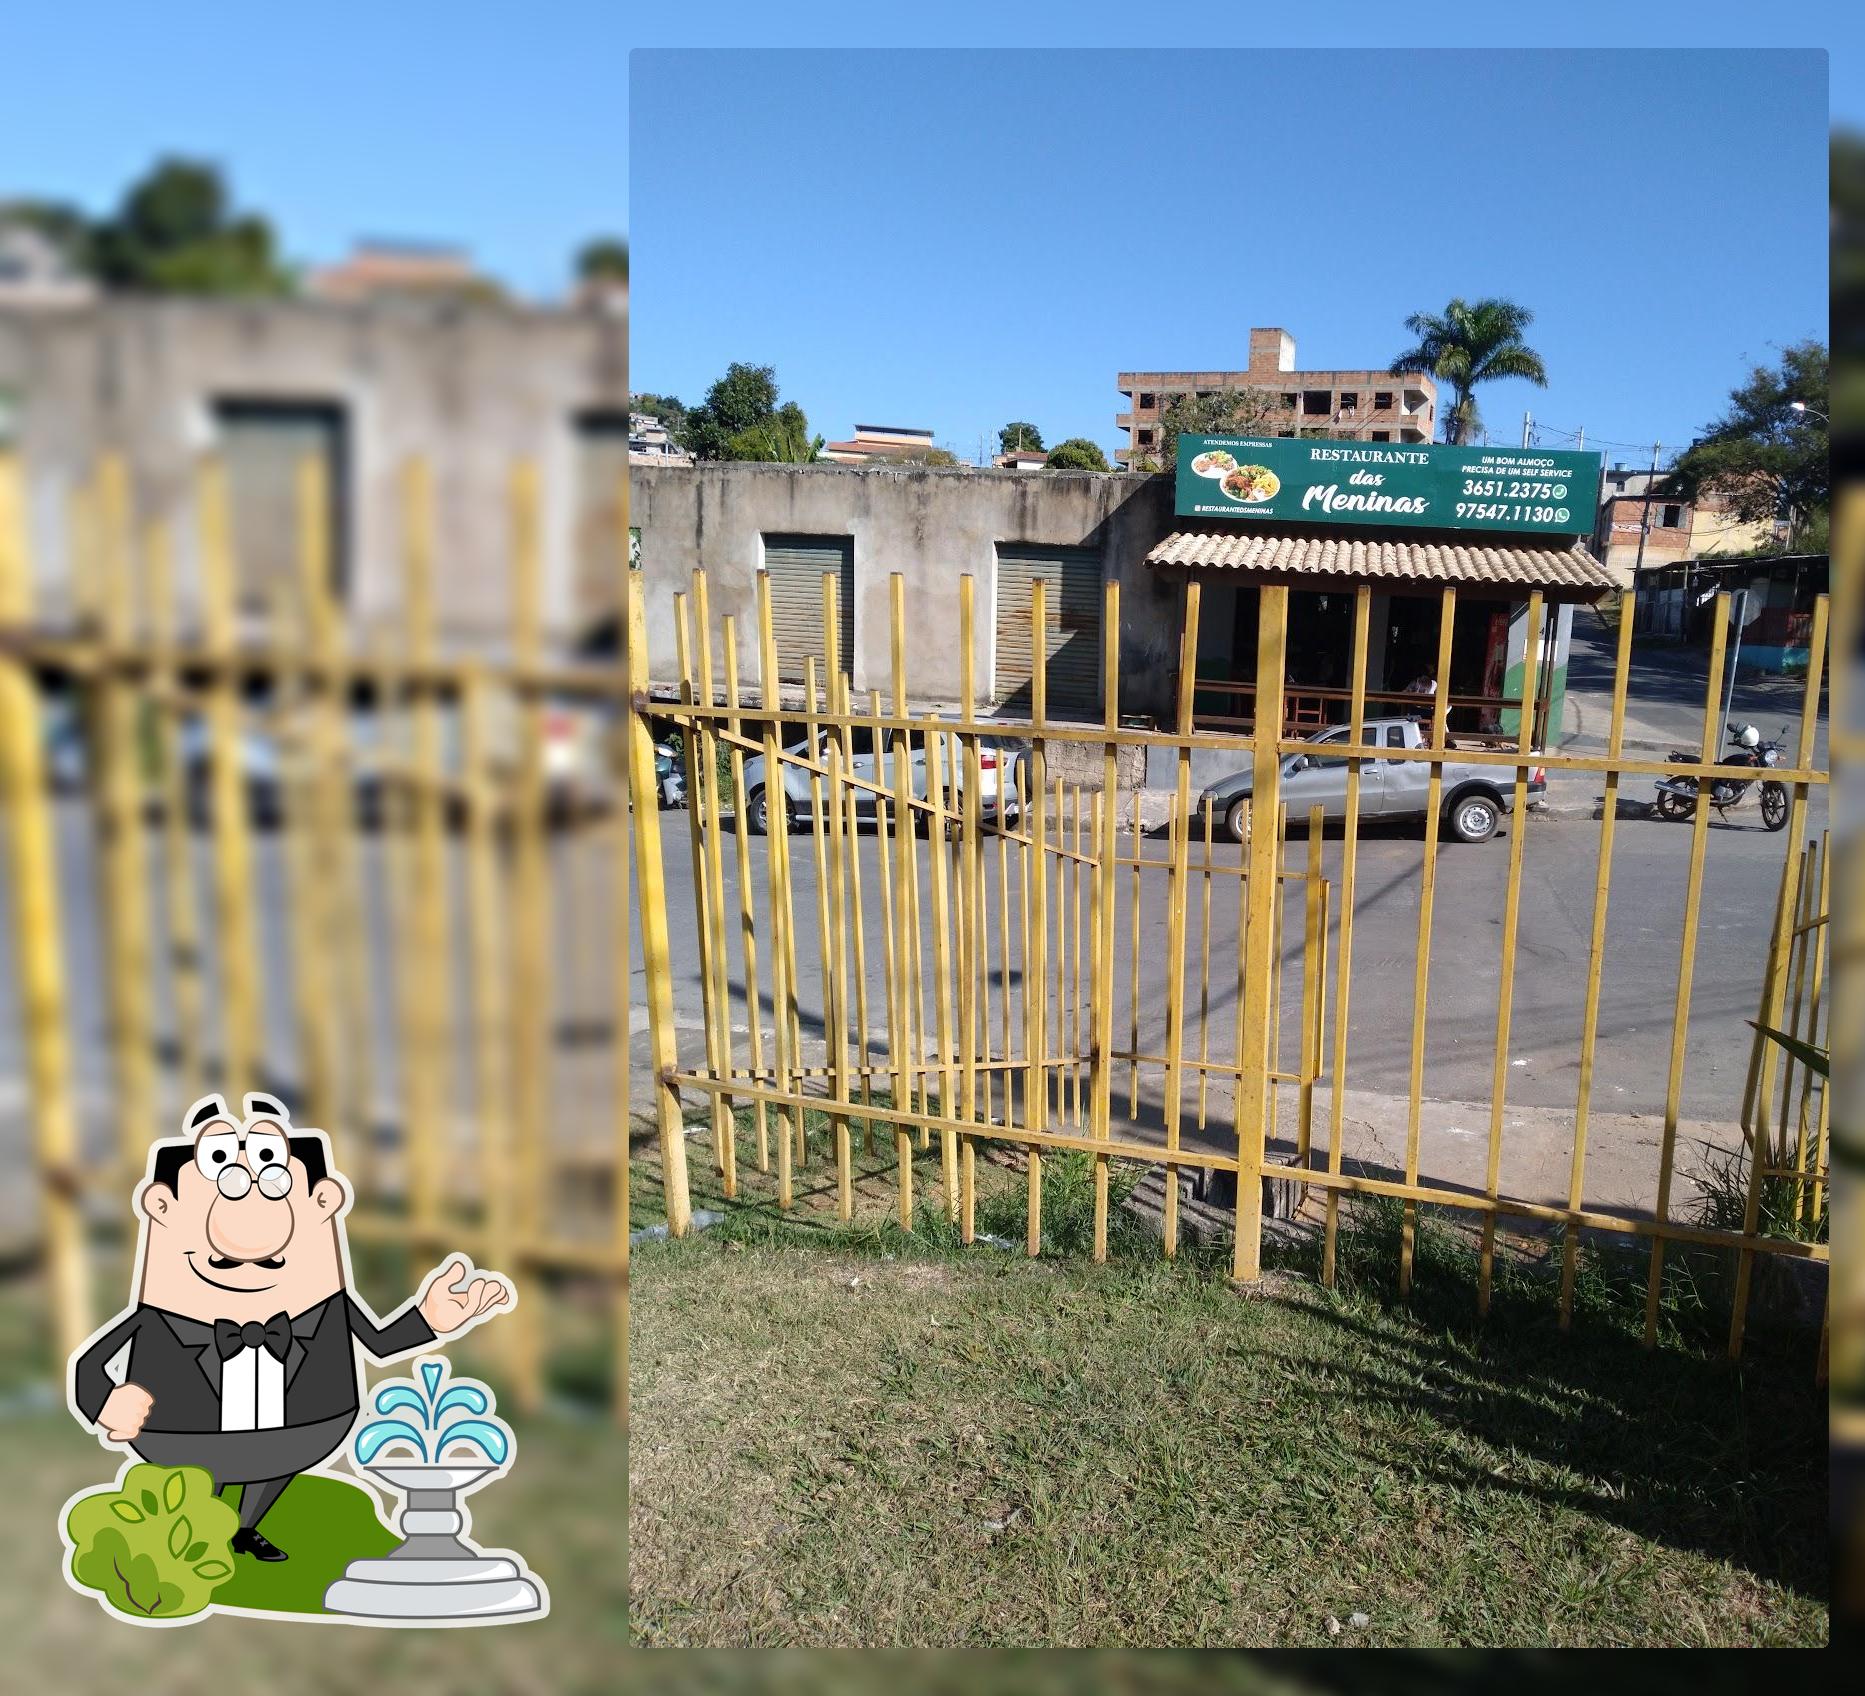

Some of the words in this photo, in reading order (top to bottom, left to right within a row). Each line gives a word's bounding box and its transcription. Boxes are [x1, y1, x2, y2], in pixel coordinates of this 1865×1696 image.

[1310, 448, 1430, 465] RESTAURANTE
[1482, 456, 1495, 464] UM
[1496, 457, 1516, 465] BOM
[1517, 458, 1555, 468] ALMOÇO
[1349, 468, 1386, 487] das
[1461, 465, 1494, 475] PRECISA
[1495, 467, 1506, 475] DE
[1507, 467, 1521, 476] UM
[1521, 468, 1539, 477] SELF
[1540, 469, 1573, 478] SERVICE
[1302, 484, 1431, 514] Meninas
[1462, 479, 1552, 500] 3651.2375
[1455, 502, 1554, 523] 97547.1130
